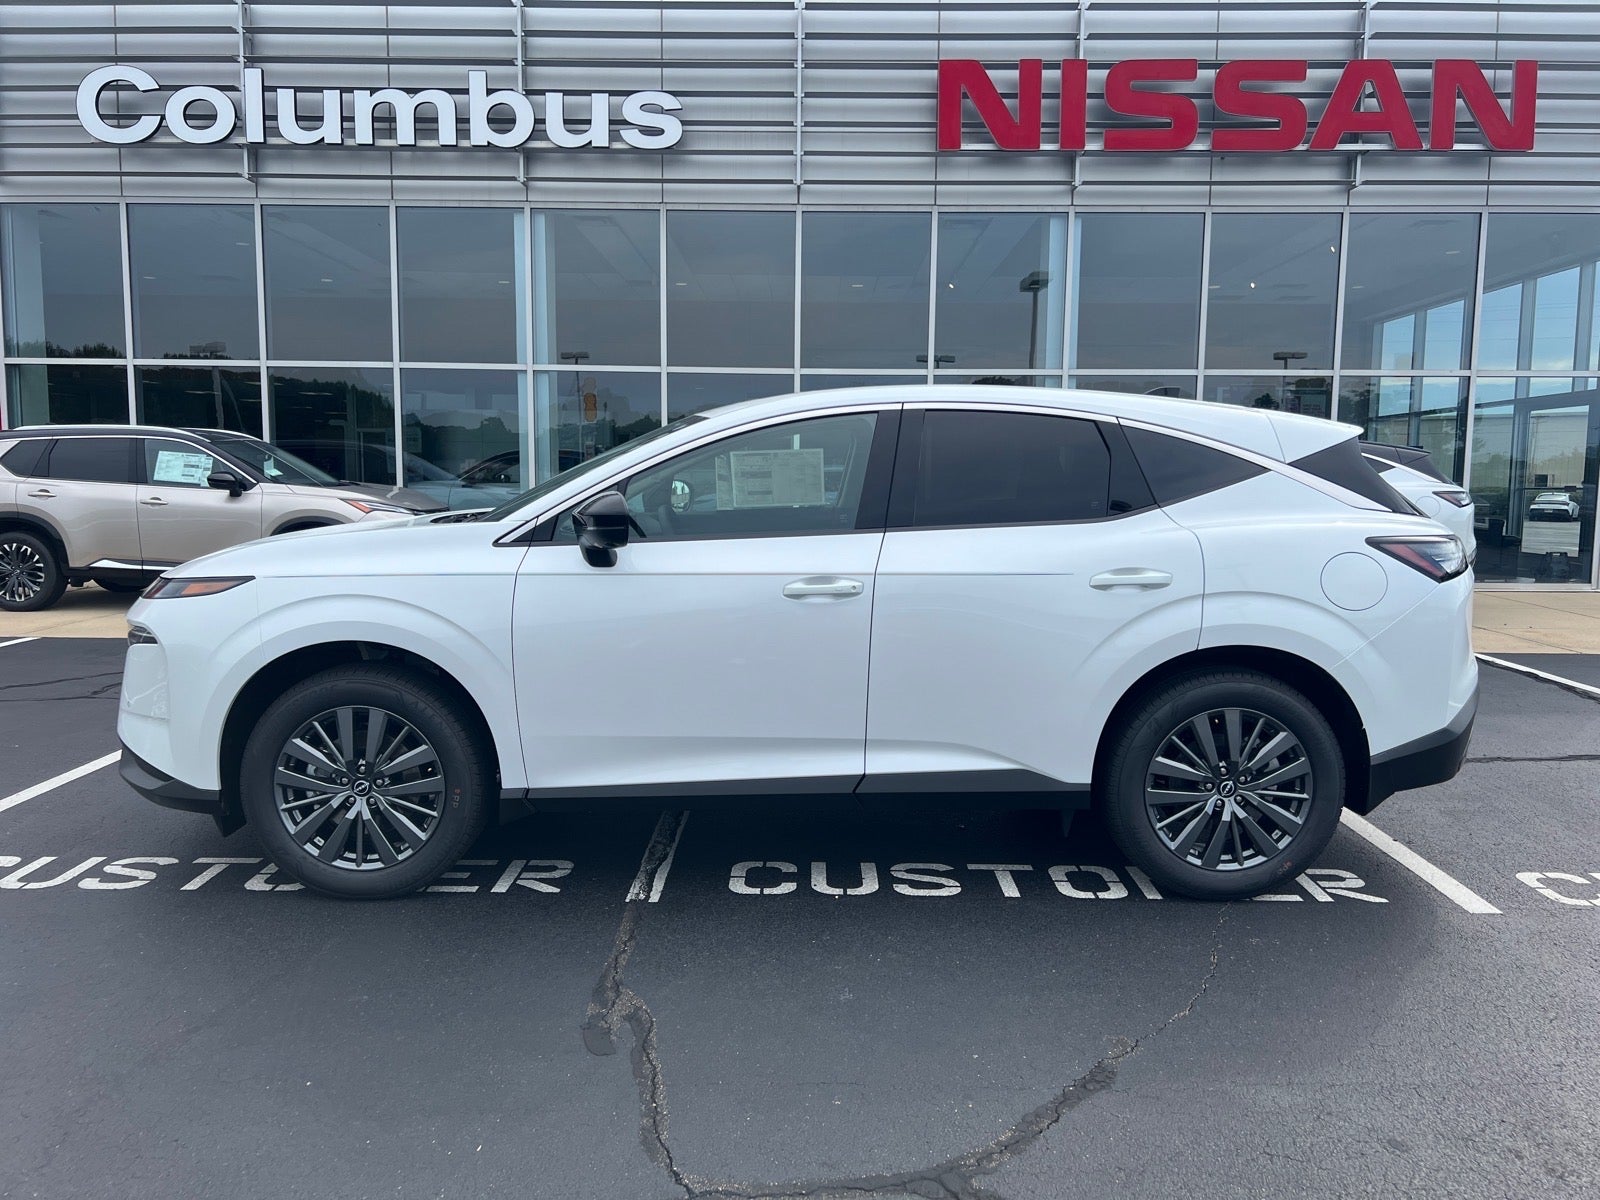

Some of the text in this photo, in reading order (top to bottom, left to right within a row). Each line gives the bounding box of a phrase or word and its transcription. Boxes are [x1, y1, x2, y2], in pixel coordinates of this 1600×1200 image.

[76, 64, 684, 149] Columbus
[937, 58, 1538, 152] NISSAN
[728, 861, 1389, 903] CUSTOR
